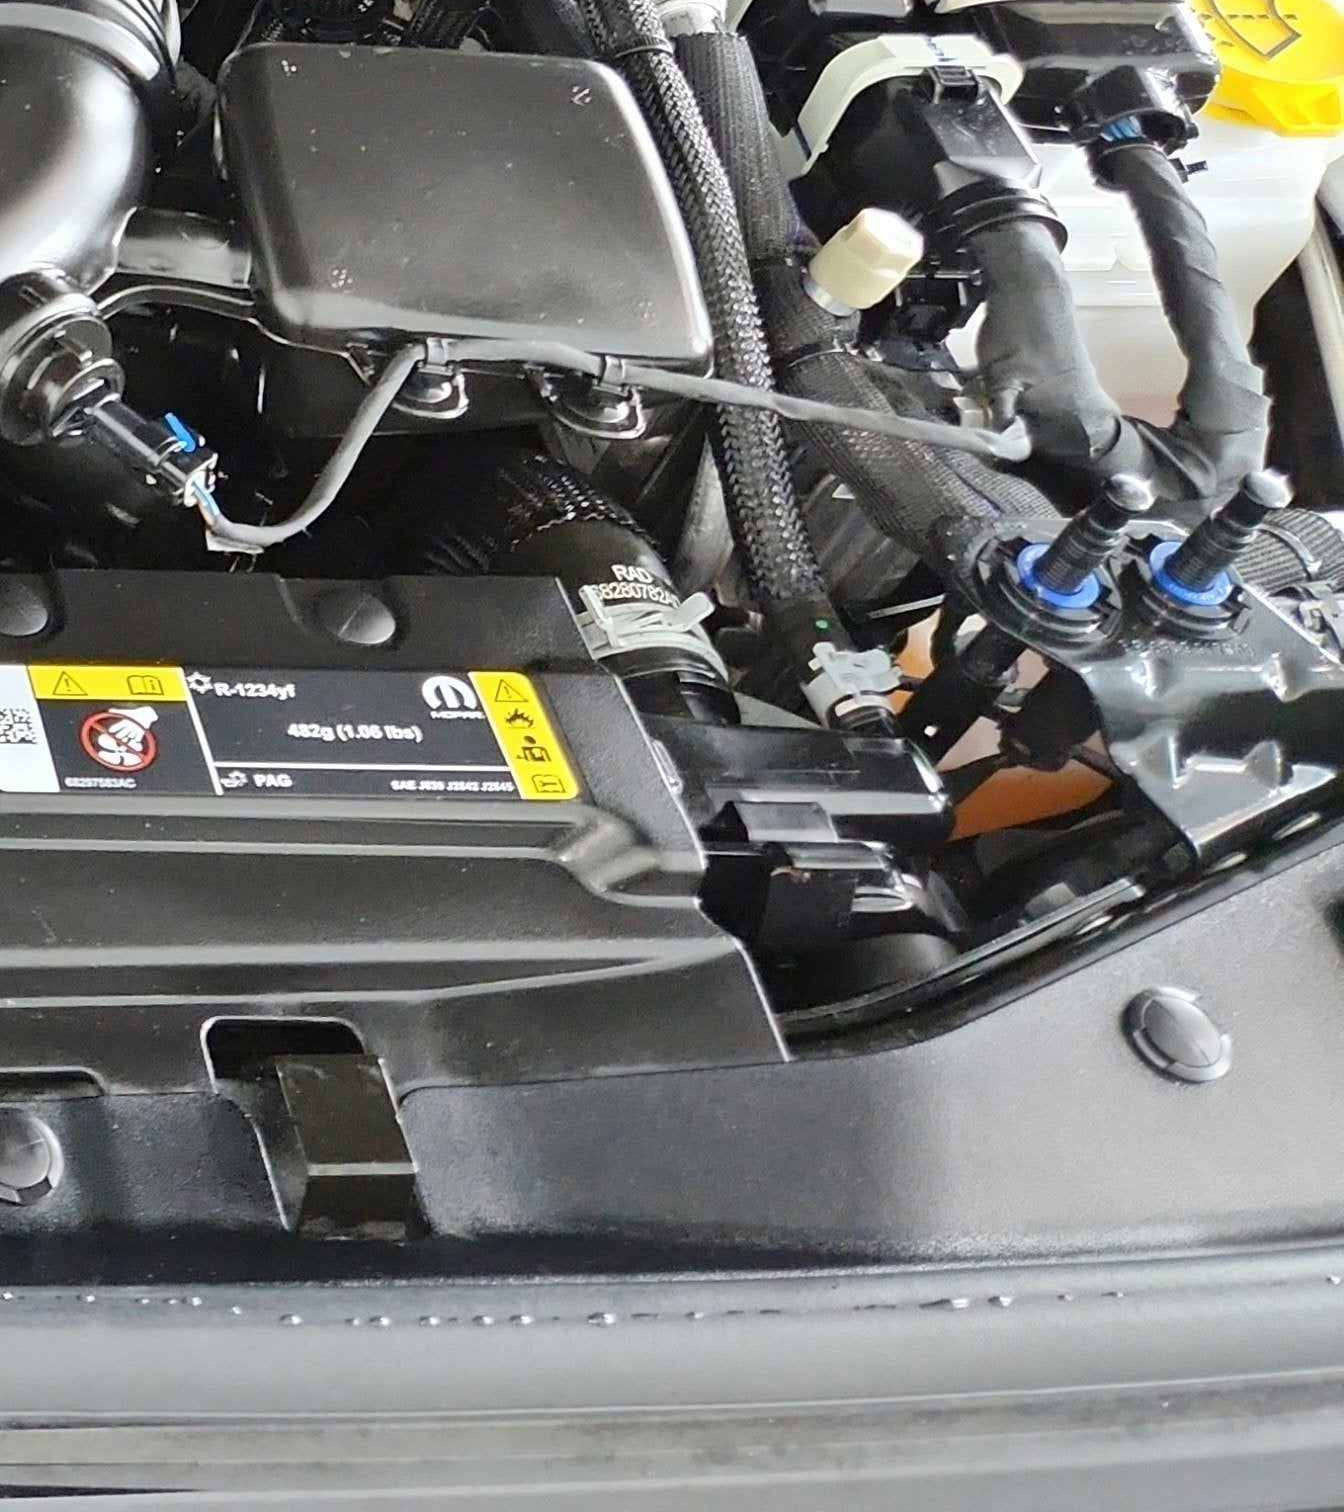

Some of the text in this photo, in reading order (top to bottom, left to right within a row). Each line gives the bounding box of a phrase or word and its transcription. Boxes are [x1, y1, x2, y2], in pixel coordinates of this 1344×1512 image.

[611, 564, 654, 584] RAD
[213, 681, 296, 700] R-1234yf
[287, 723, 423, 743] 482g (1.06 lbs)
[252, 773, 293, 788] PAG
